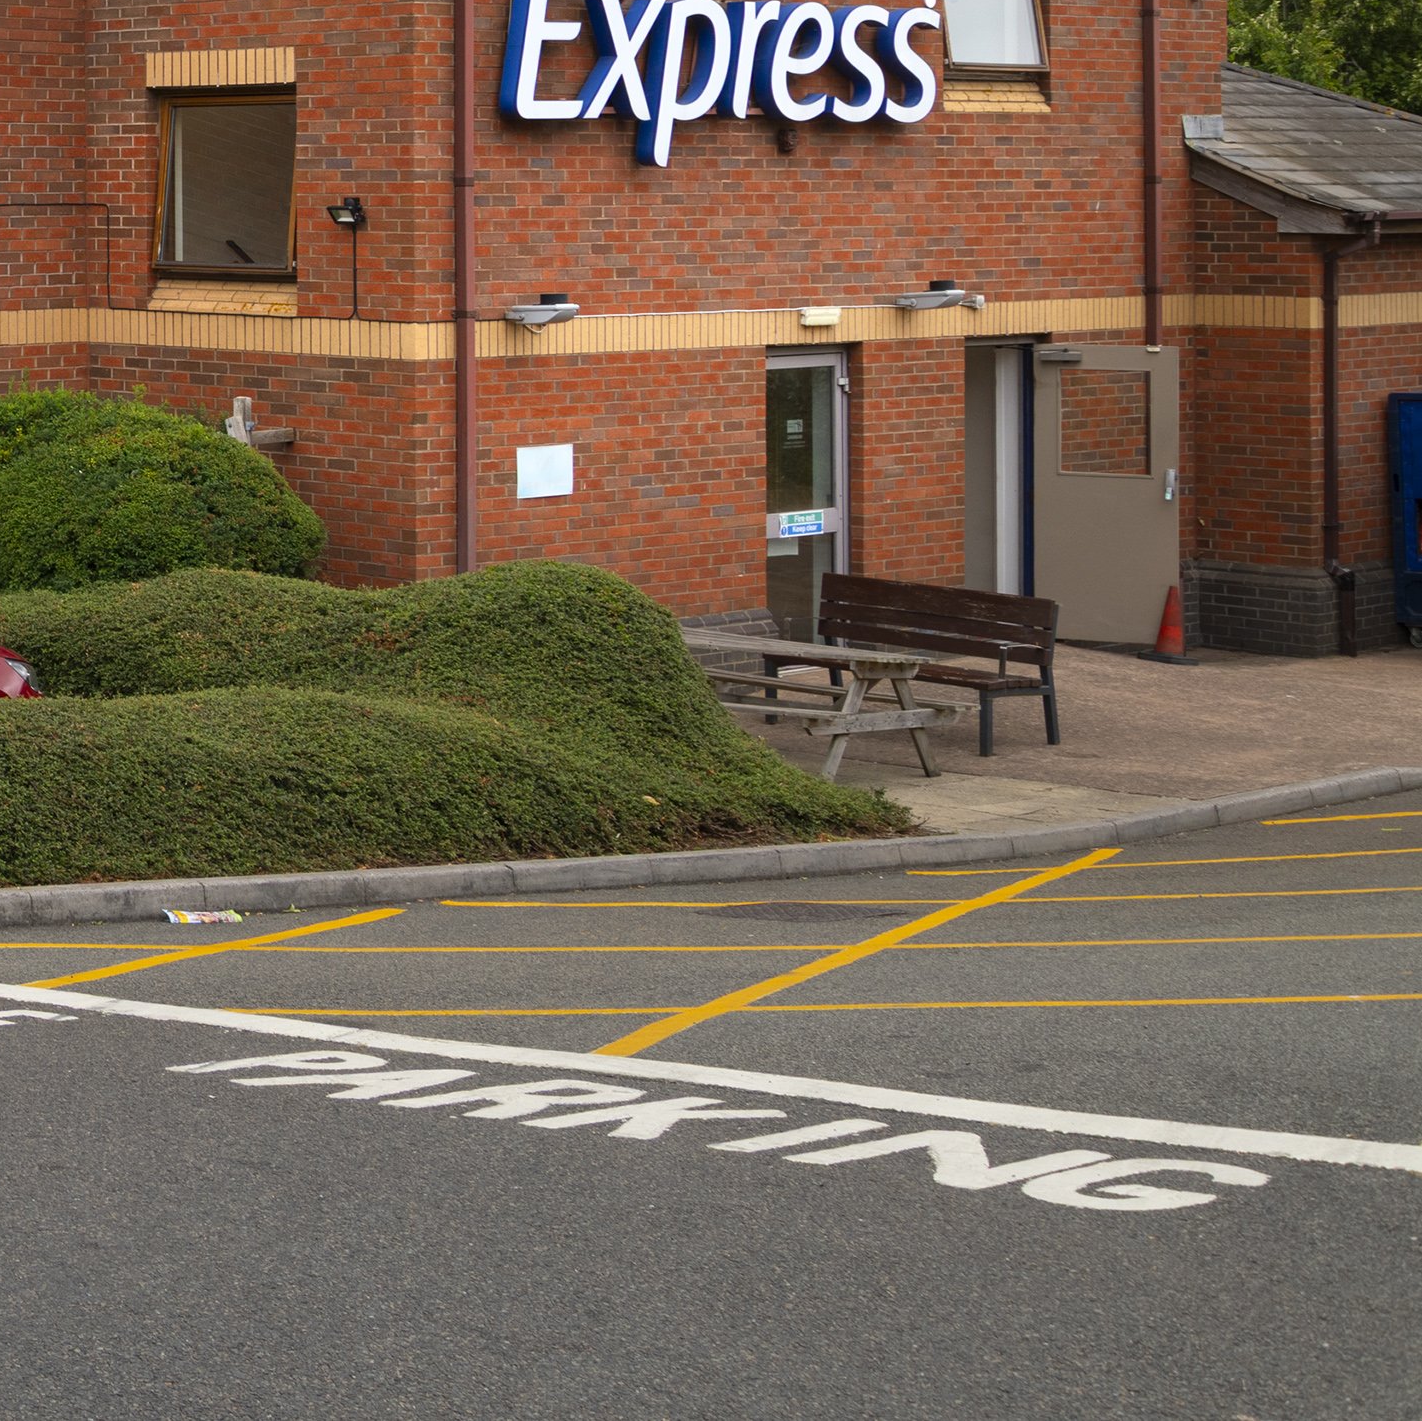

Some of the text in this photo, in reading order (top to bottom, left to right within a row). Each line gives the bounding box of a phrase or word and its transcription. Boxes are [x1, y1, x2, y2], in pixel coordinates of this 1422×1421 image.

[794, 513, 816, 523] Fire exit
[792, 524, 818, 534] Keep clear
[163, 1049, 1273, 1212] PARKING
